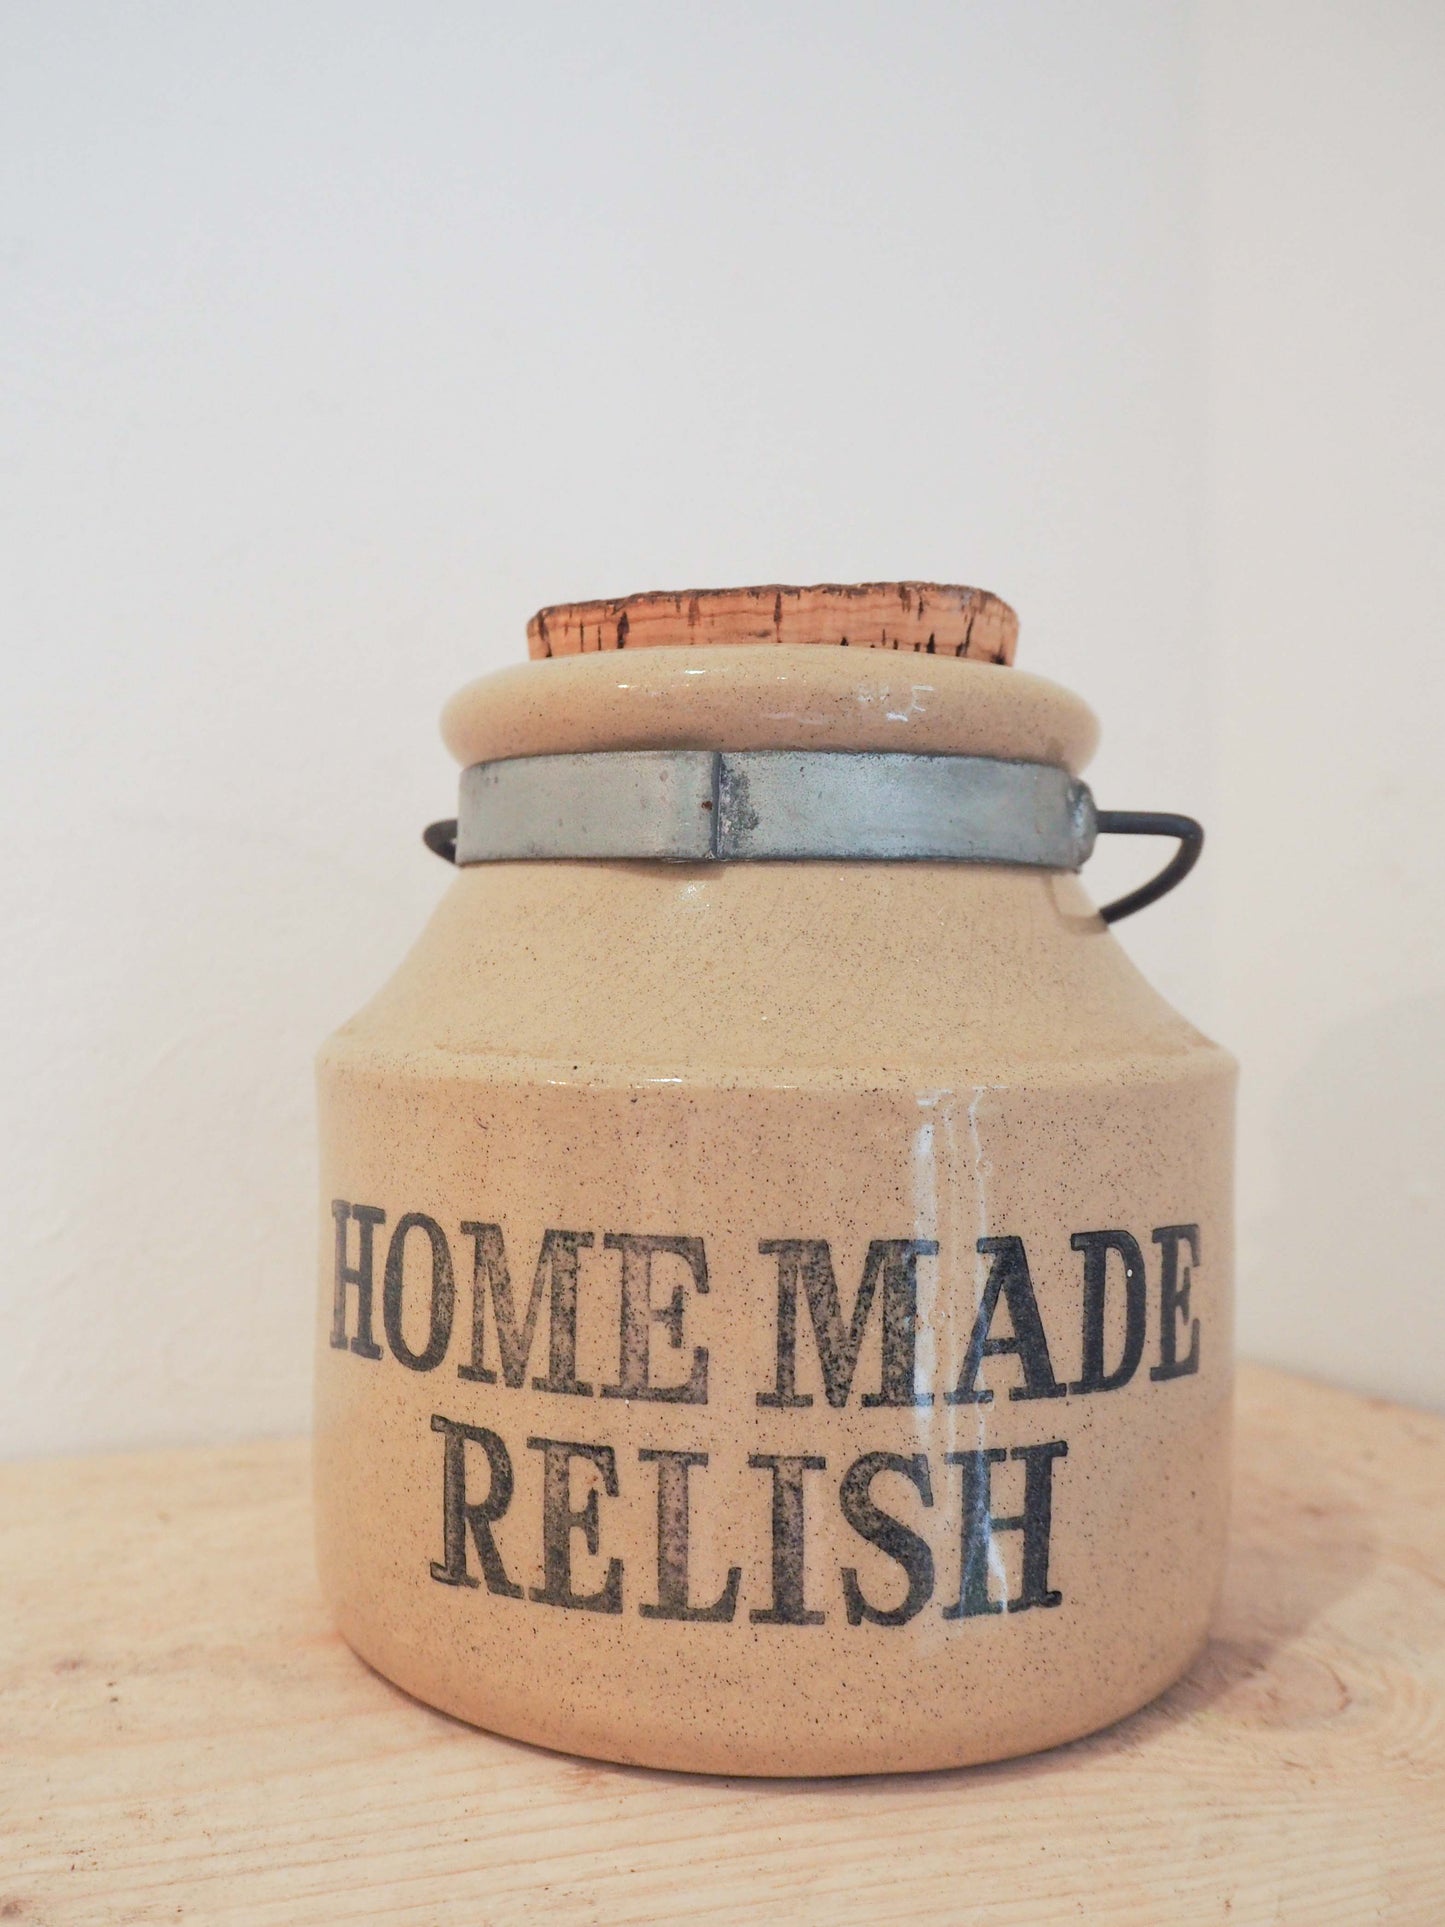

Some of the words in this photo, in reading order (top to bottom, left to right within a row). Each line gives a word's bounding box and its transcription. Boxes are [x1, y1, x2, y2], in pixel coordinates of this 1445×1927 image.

[330, 1199, 709, 1405] HOME
[755, 1224, 1201, 1411] MADE
[429, 1413, 1069, 1627] RELISH
